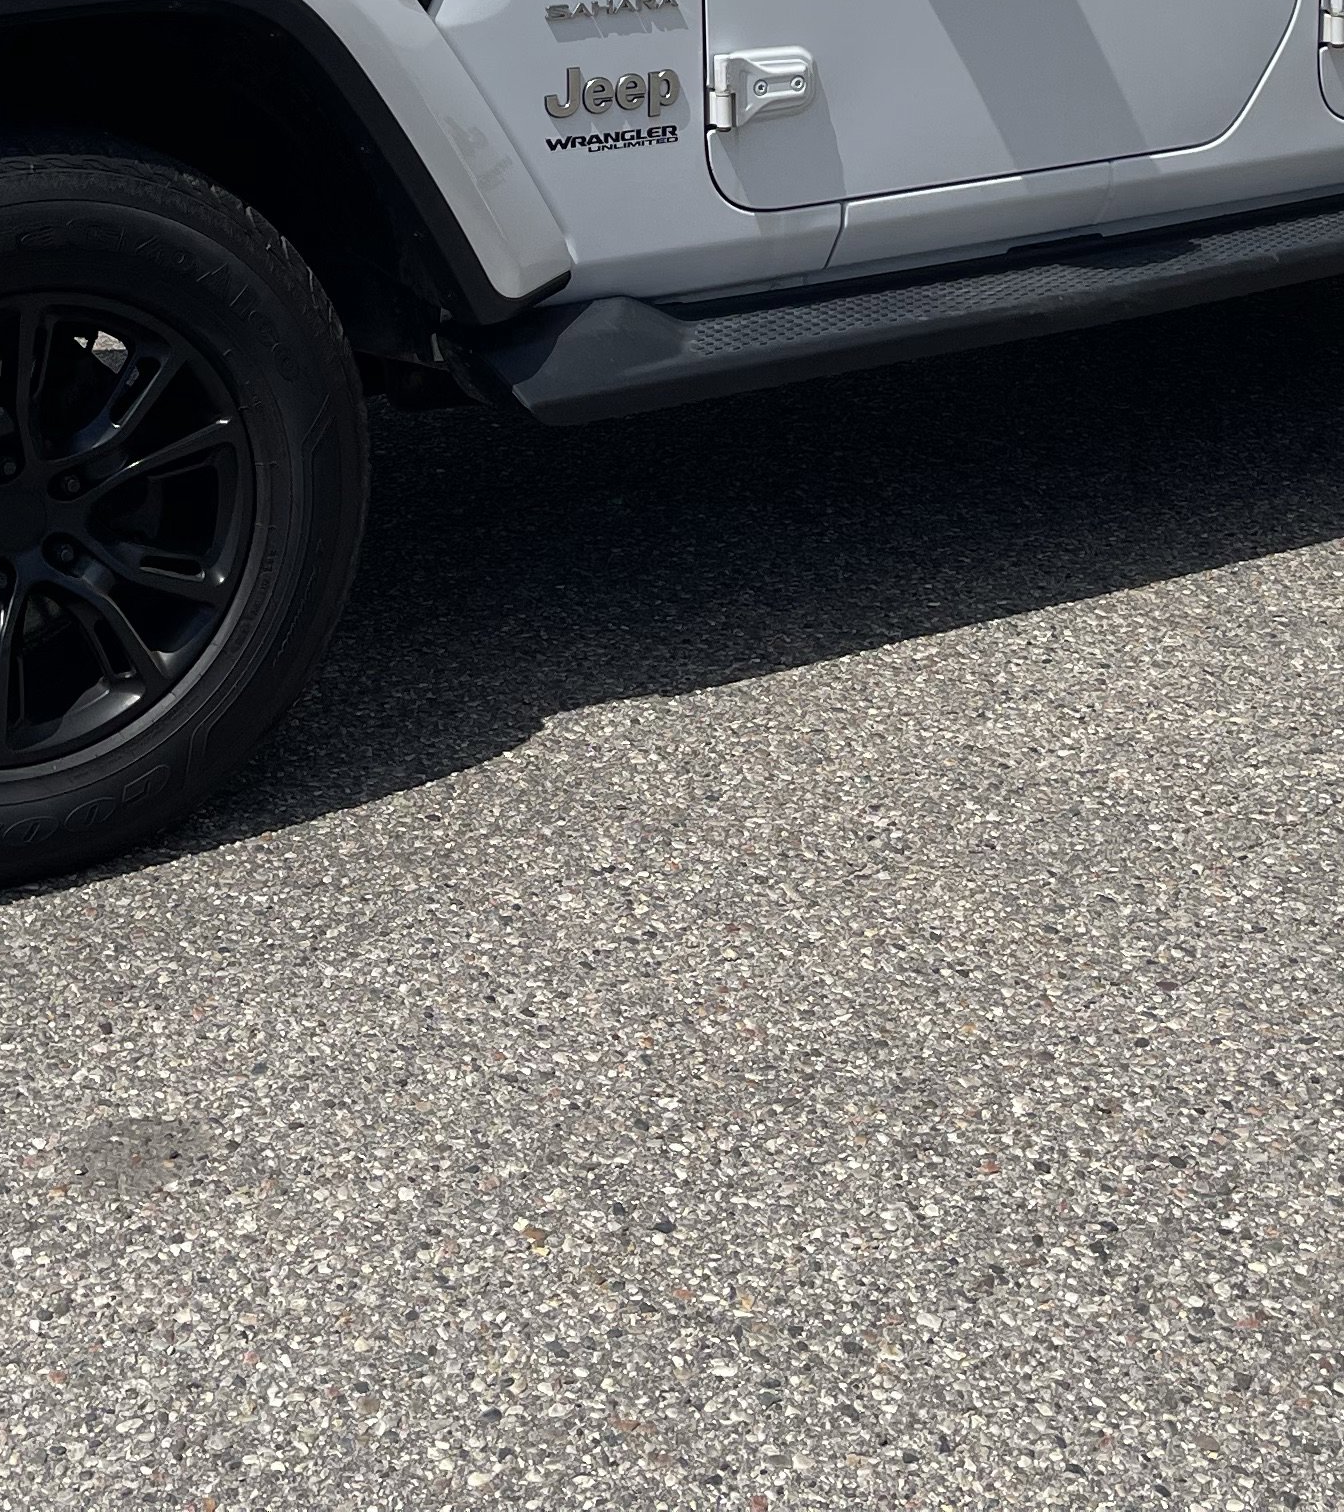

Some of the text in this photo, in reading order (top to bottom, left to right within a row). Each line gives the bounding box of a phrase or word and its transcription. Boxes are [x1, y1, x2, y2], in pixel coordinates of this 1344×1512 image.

[544, 66, 681, 119] Jeep
[545, 124, 678, 152] WRANGLER
[588, 136, 679, 153] UNLIMITED
